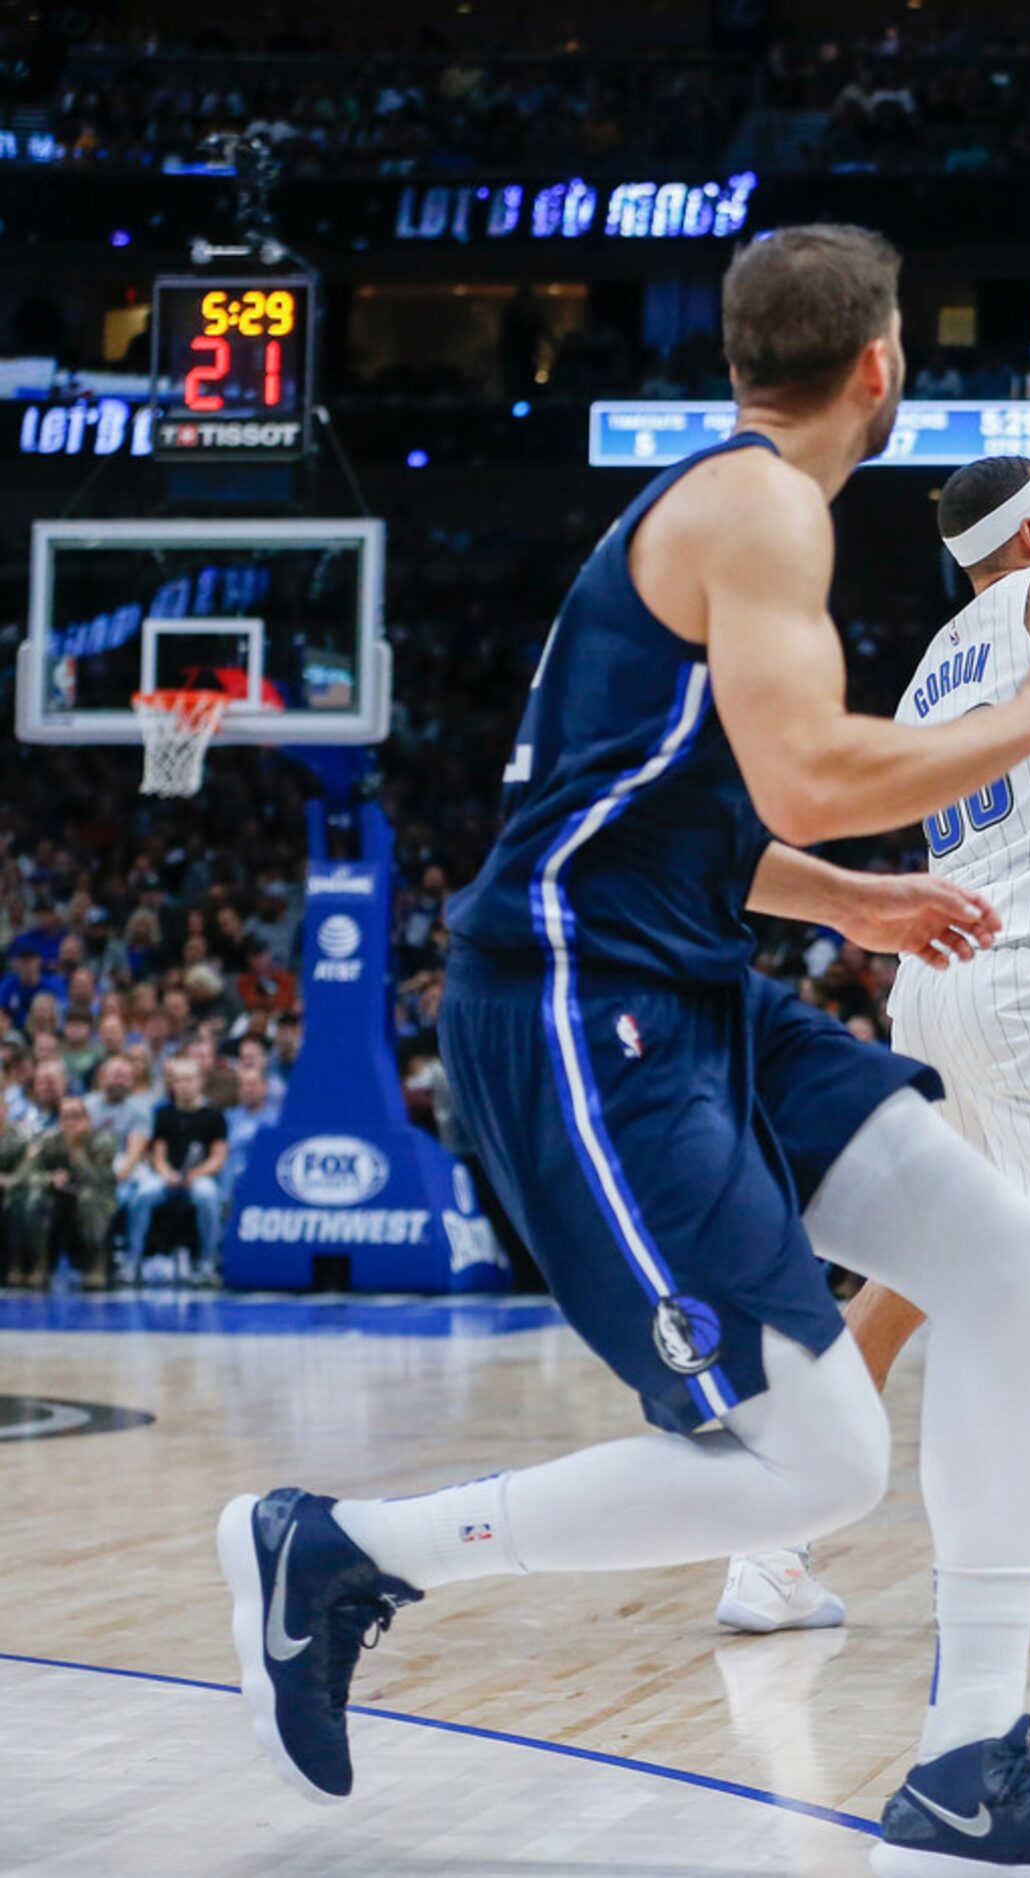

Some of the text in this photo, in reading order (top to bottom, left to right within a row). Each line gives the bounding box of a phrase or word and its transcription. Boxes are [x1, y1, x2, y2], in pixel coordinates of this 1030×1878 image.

[201, 290, 295, 336] 5:29
[184, 335, 281, 412] 21
[198, 424, 299, 448] TISSOT
[913, 642, 991, 719] GORDON
[304, 1153, 359, 1177] FOX
[237, 1204, 430, 1245] SOUTHWEST
